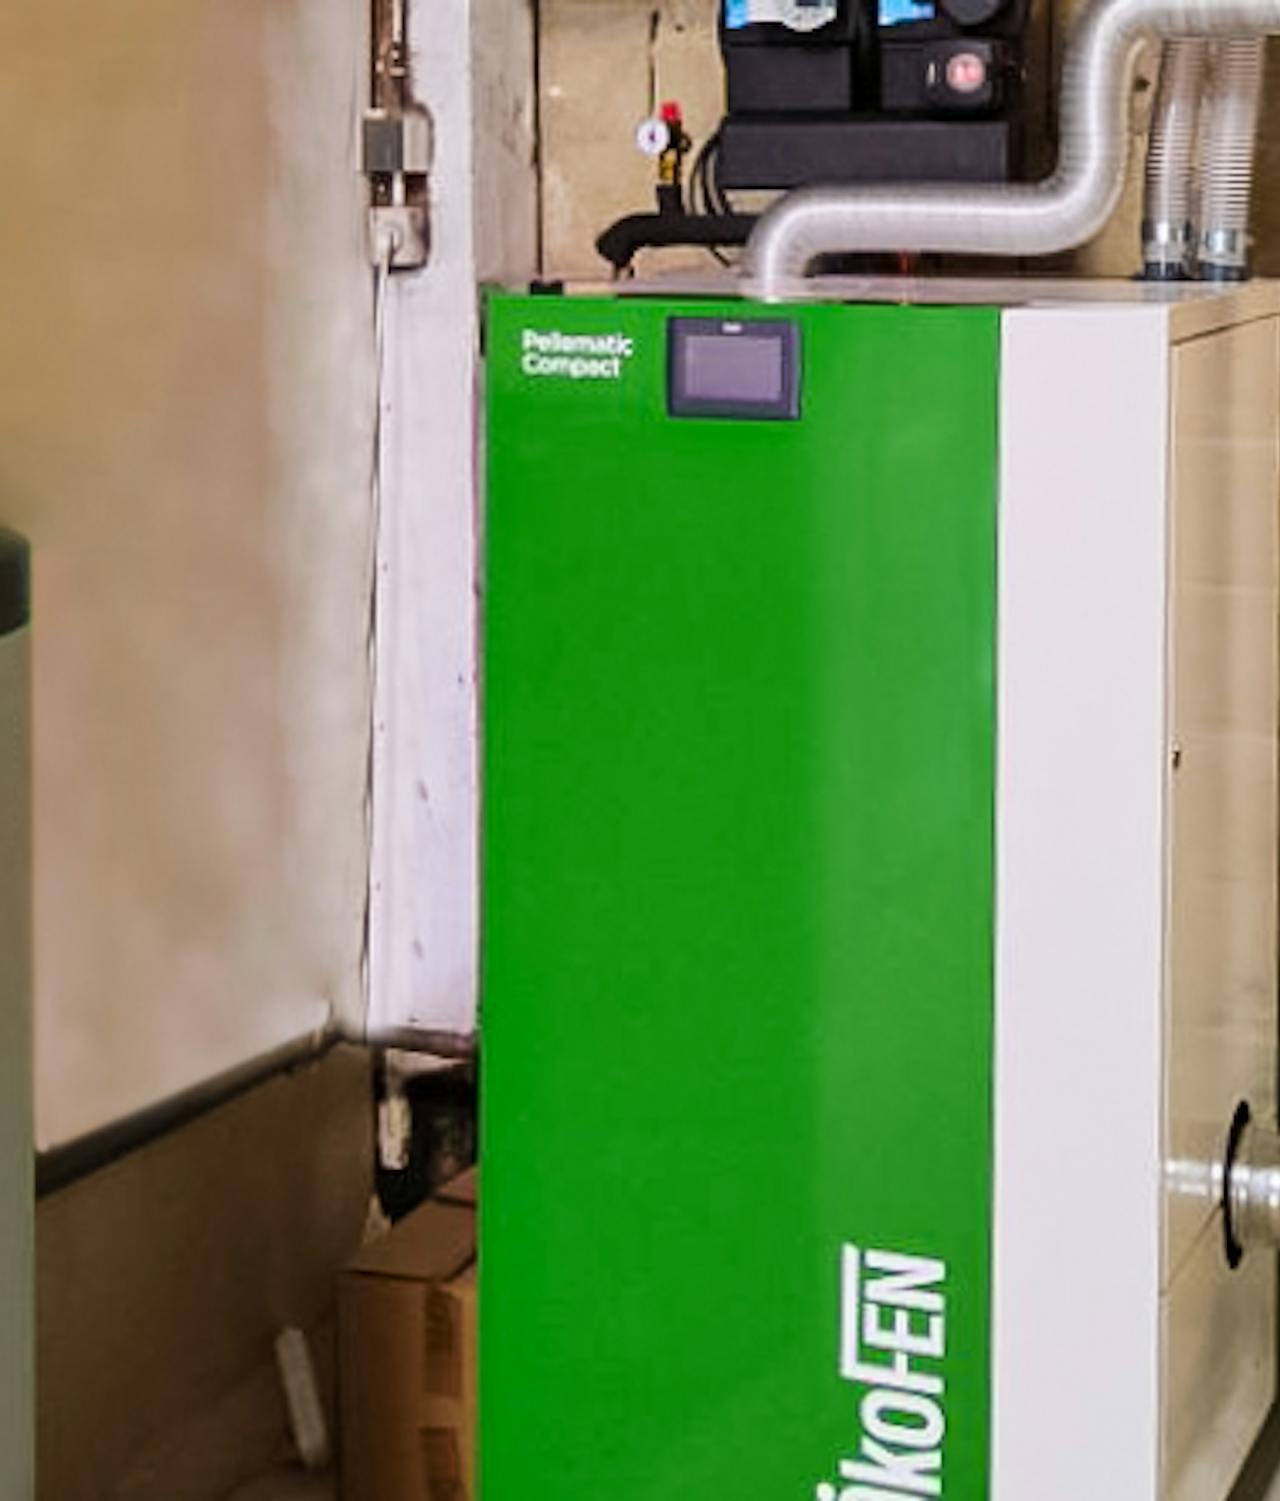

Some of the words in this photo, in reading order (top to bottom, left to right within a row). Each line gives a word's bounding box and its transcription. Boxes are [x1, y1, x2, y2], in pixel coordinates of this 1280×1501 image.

[522, 329, 634, 357] Pellematic
[522, 352, 620, 379] Compact
[816, 1242, 947, 1501] koFEN
